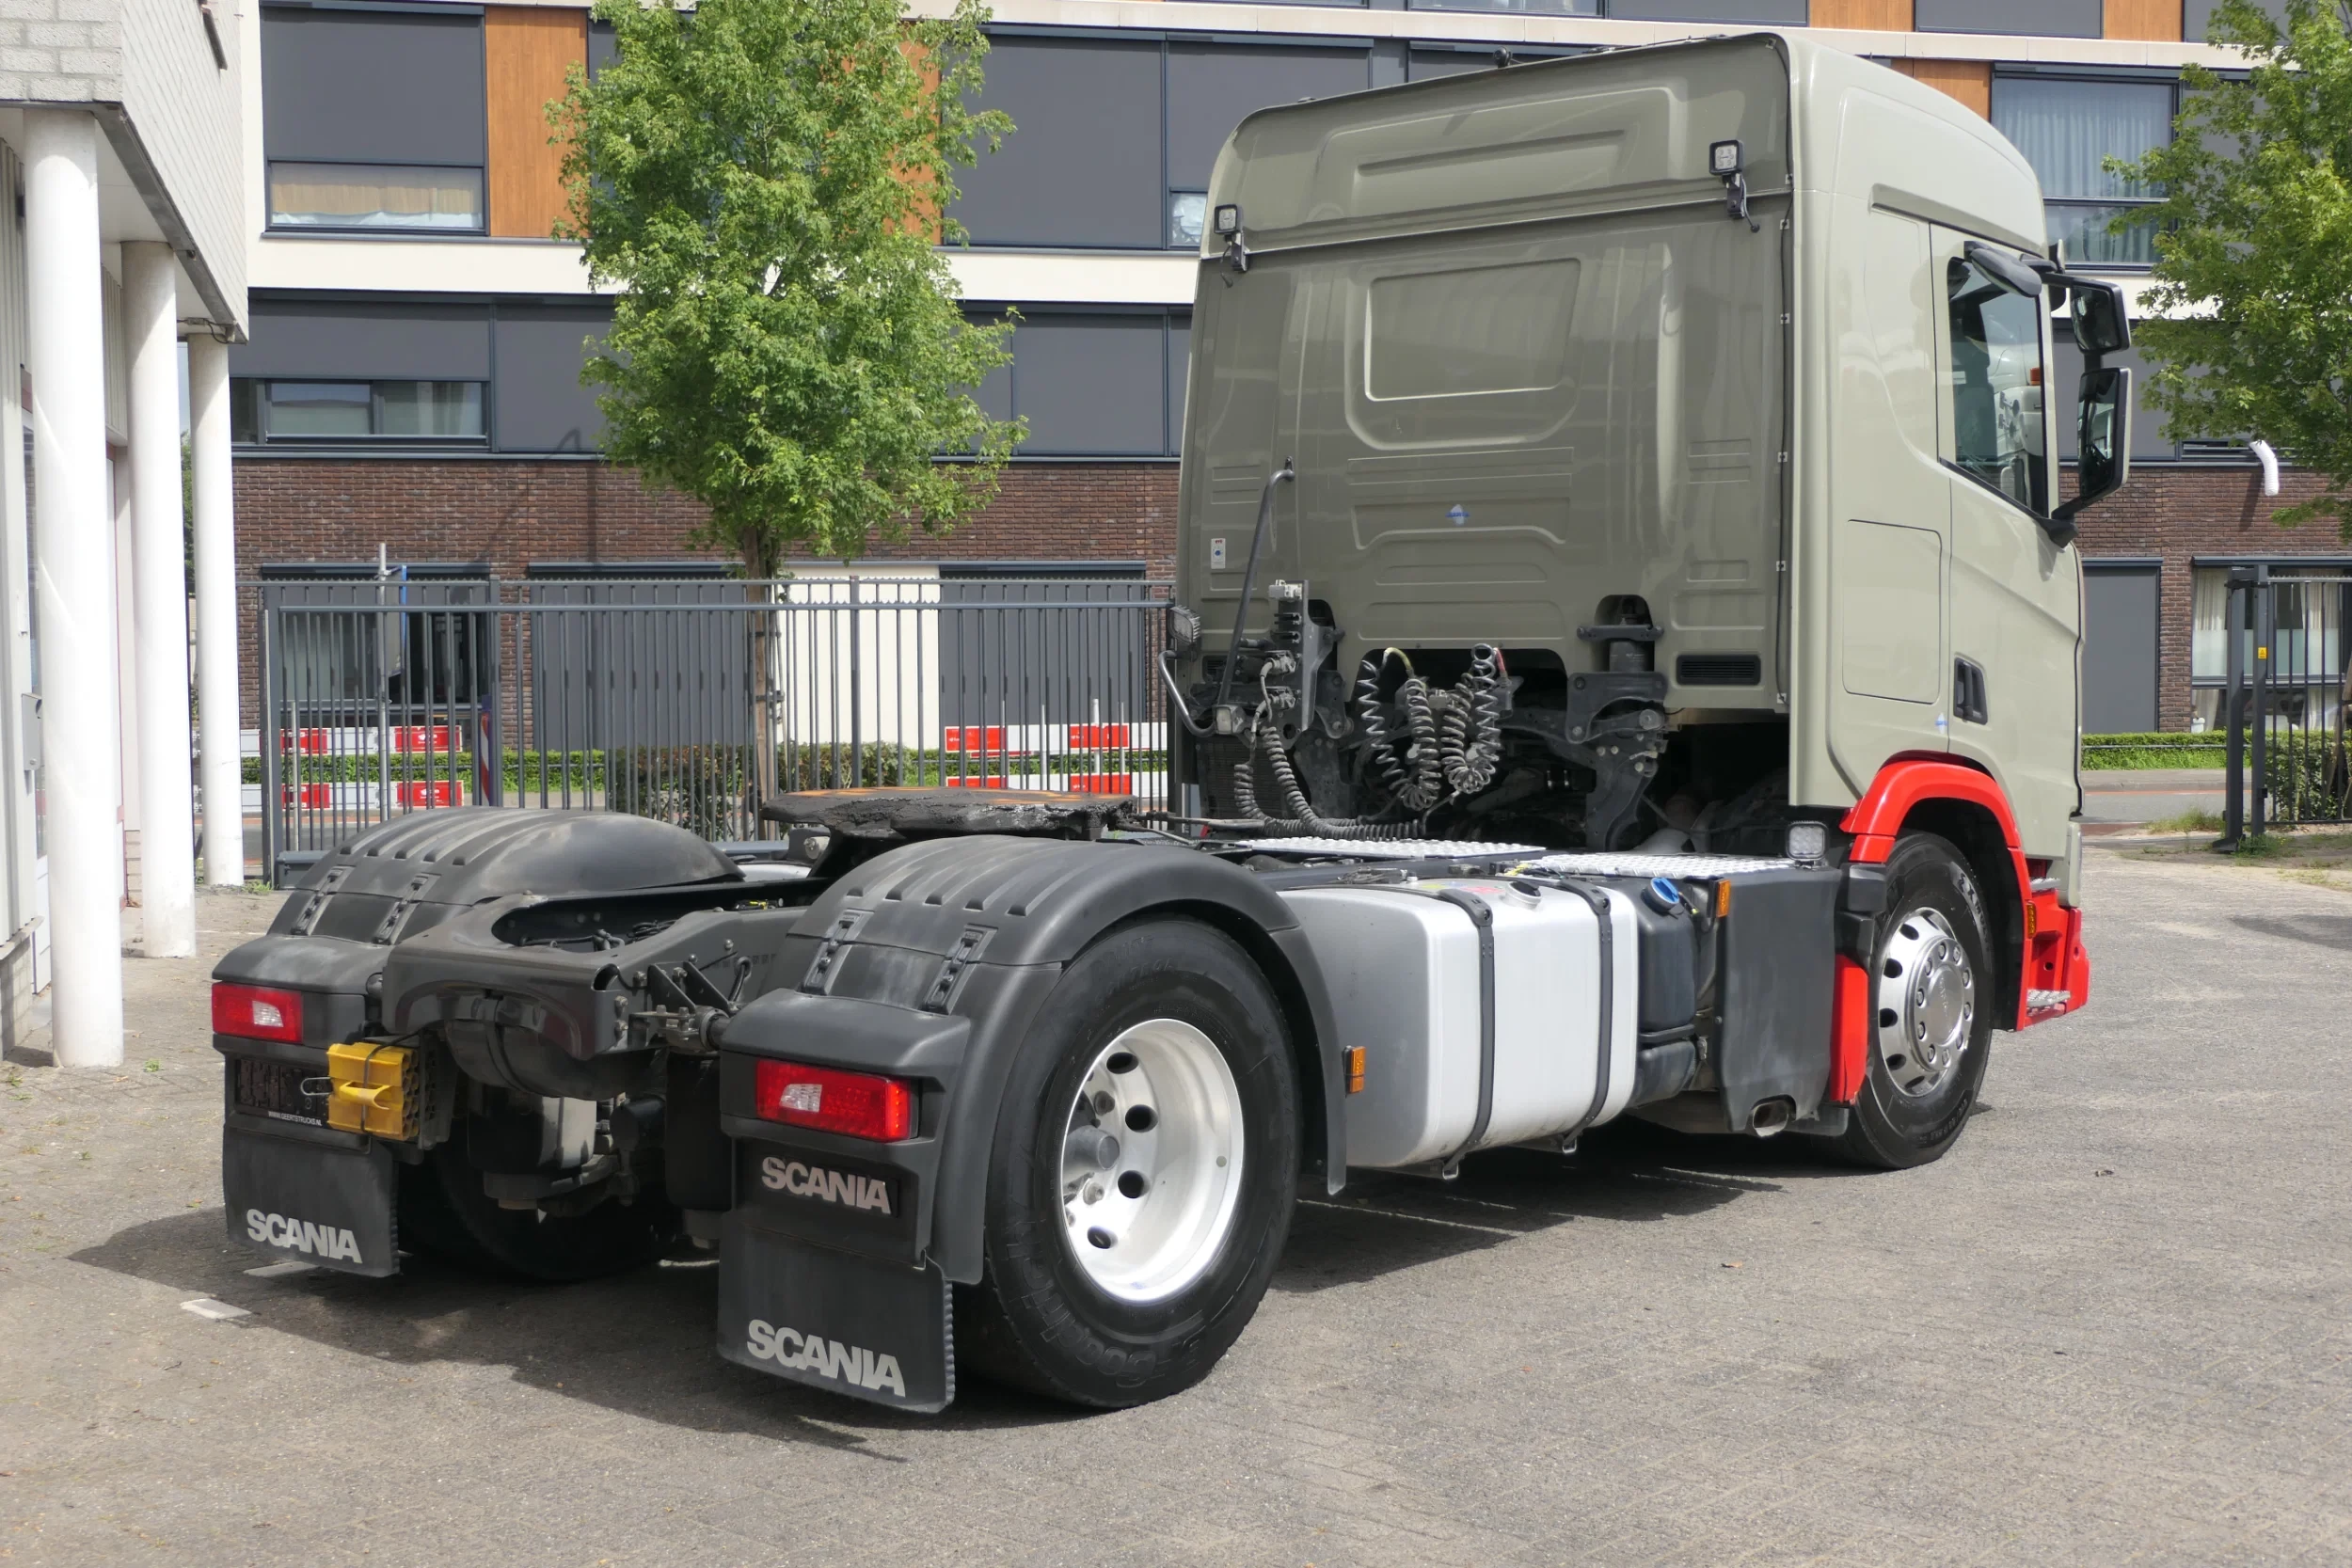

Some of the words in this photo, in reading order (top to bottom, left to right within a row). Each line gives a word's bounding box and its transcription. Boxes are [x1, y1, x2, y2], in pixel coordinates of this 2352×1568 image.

[762, 1156, 891, 1214] SCANIA
[246, 1208, 363, 1264] SCANIA
[746, 1319, 906, 1398] SCANIA
